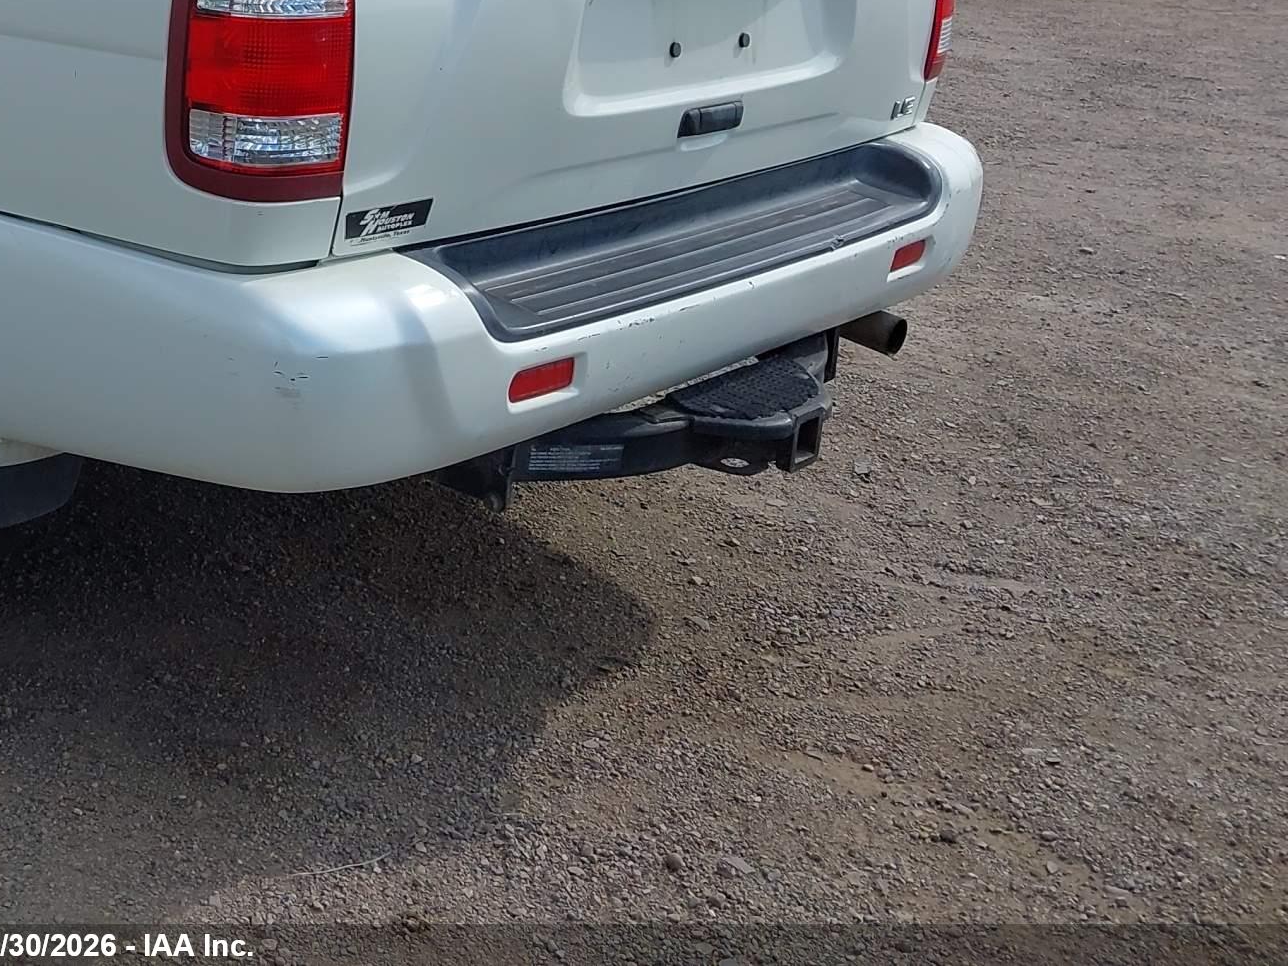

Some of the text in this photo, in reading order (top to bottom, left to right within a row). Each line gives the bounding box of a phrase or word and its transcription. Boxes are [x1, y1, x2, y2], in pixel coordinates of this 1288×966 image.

[890, 96, 916, 121] LE
[360, 212, 415, 237] HOUSTON
[375, 220, 413, 233] AUTOPLEX
